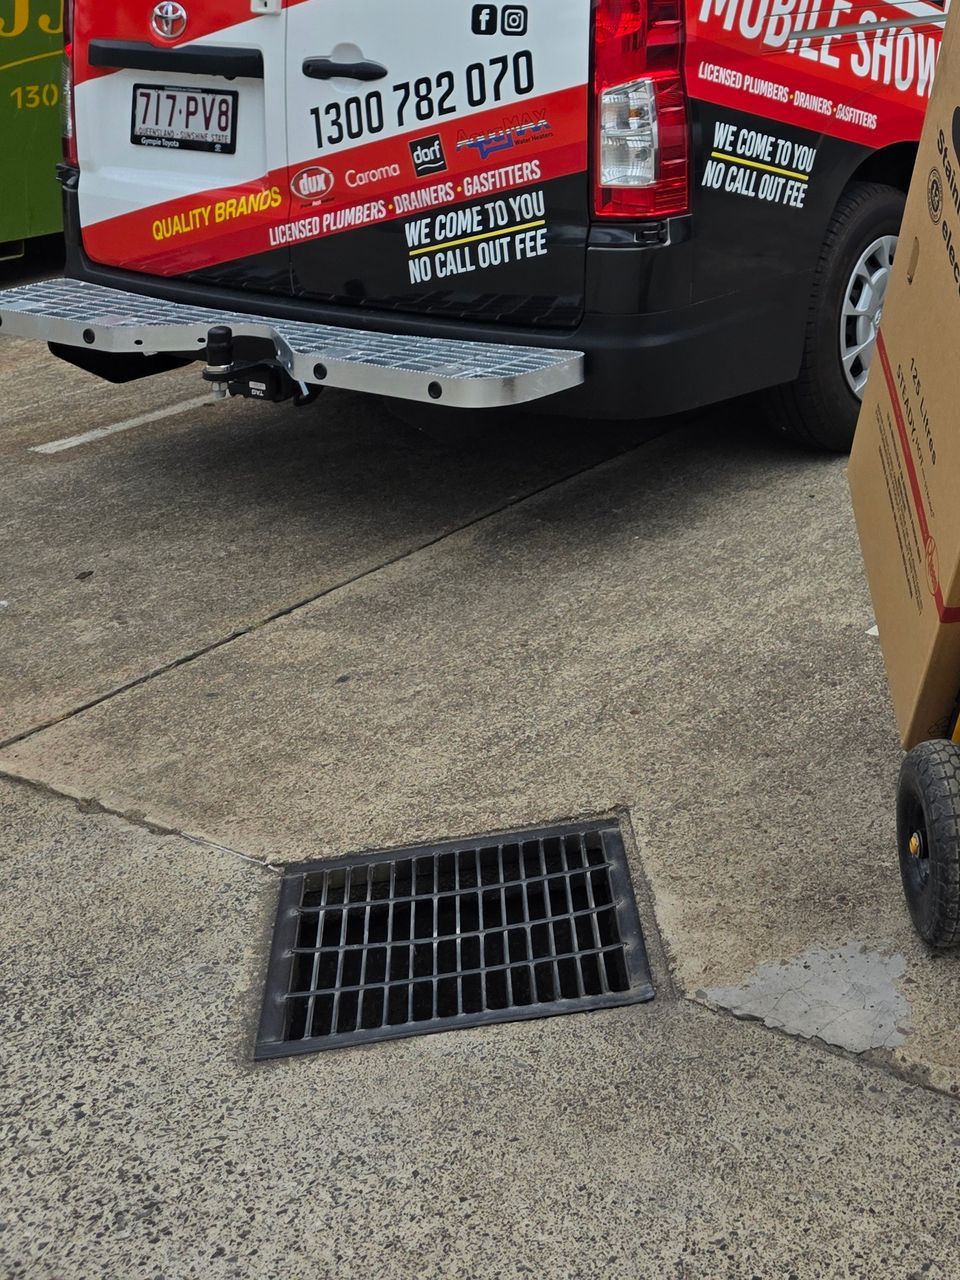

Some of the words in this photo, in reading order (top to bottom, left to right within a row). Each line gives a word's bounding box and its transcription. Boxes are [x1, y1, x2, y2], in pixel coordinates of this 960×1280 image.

[310, 91, 383, 148] 1300
[393, 71, 456, 127] 782
[466, 50, 534, 107] 070
[698, 61, 742, 89] LICENSED
[744, 76, 789, 103] PLUMBERS
[794, 90, 832, 116] DRAINERS
[836, 104, 877, 130] GASFITTERS
[162, 139, 179, 148] Toyota
[413, 140, 441, 164] dorf
[713, 122, 737, 151] WE
[736, 128, 775, 162] COME
[775, 139, 792, 166] TO
[792, 144, 816, 172] YOU
[299, 174, 326, 195] dux
[345, 163, 400, 187] Caroma
[701, 160, 725, 189] NO
[725, 166, 756, 197] CALL
[758, 174, 786, 203] OUT
[783, 180, 808, 208] FEE
[152, 205, 211, 241] QUALITY
[214, 187, 282, 223] BRANDS
[268, 216, 320, 247] LICENSED
[321, 200, 387, 233] PLUMBERS
[394, 181, 455, 214] DRAINERS
[463, 160, 541, 197] GASFITTERS
[404, 220, 430, 248] WE
[434, 206, 482, 242] COME
[484, 202, 509, 228] TO
[510, 191, 545, 221] YOU
[408, 259, 432, 285] NO
[434, 245, 476, 278] CALL
[478, 237, 513, 269] OUT
[514, 228, 548, 259] FEE
[910, 357, 921, 396] 125
